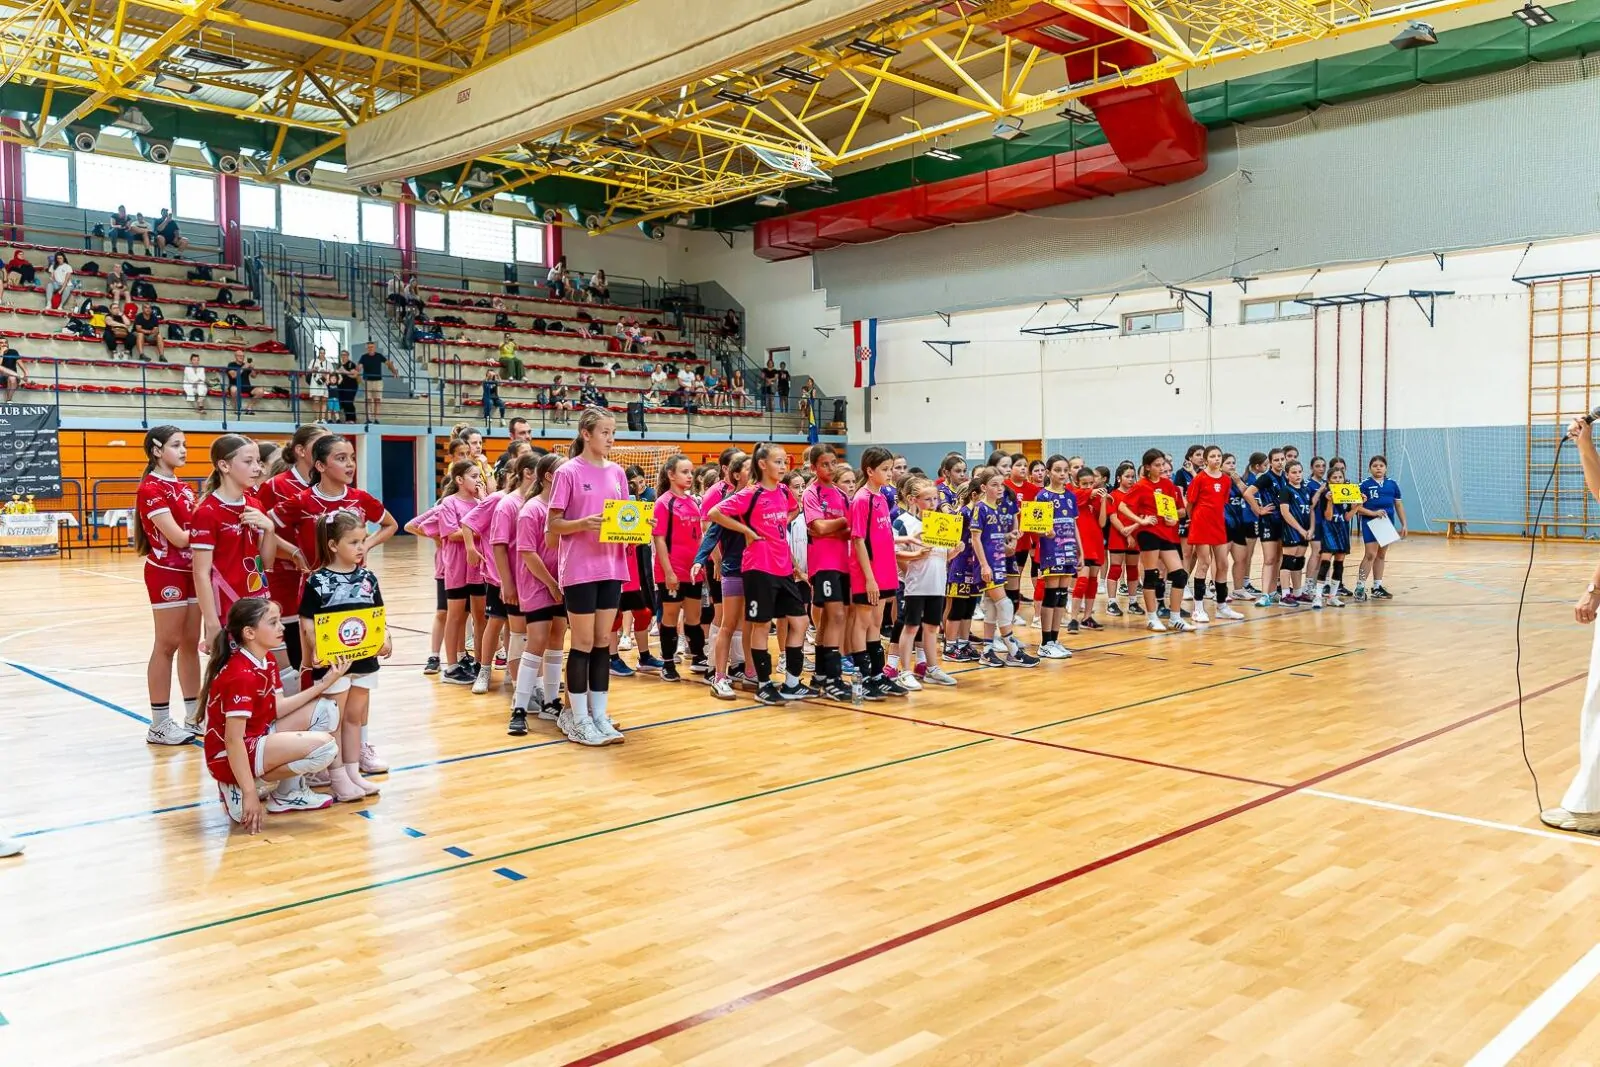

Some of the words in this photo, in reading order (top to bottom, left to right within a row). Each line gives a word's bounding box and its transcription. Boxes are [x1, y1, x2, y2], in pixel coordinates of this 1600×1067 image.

[22, 406, 49, 416] KNIN
[1299, 504, 1311, 514] 75
[777, 524, 786, 540] 9
[823, 580, 832, 597] 6
[749, 600, 758, 617] 3
[338, 650, 369, 661] IHAC
